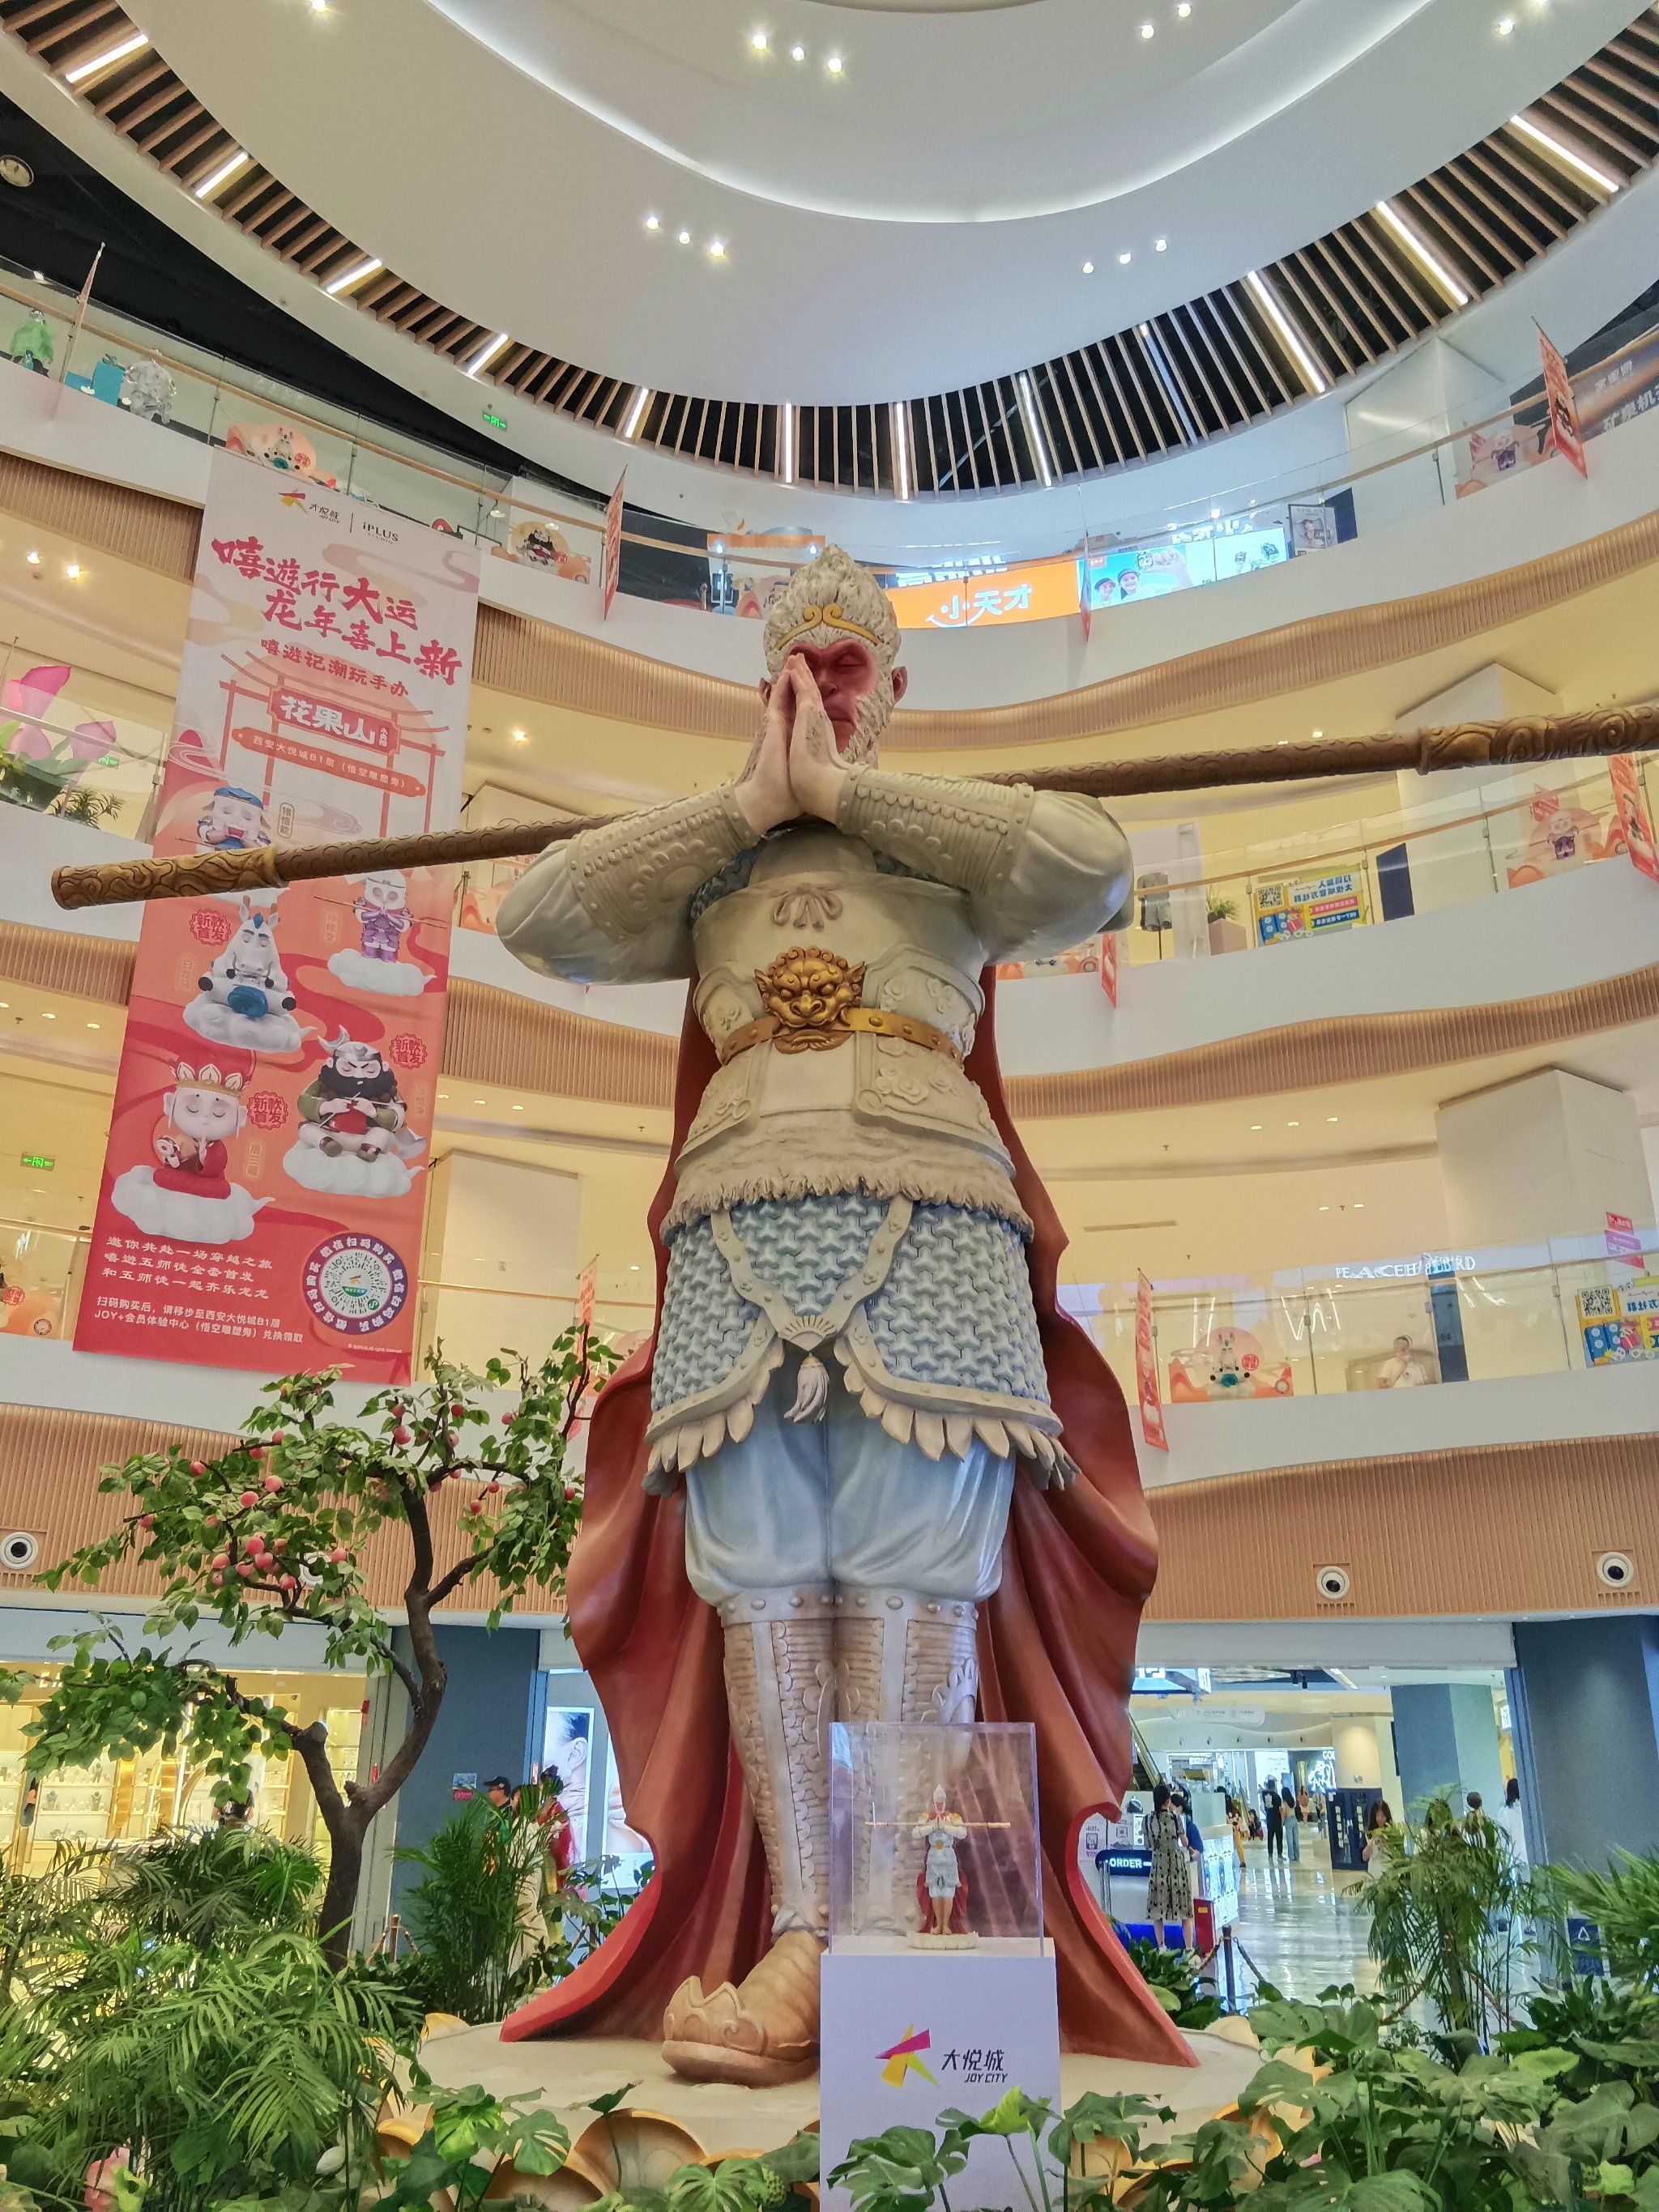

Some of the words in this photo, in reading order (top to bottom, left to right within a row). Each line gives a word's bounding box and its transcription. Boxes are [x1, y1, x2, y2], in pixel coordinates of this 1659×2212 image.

[309, 503, 339, 520] 大悦城
[363, 522, 399, 542] iPLUS
[932, 584, 1033, 624] 小天才
[263, 589, 463, 686] 龙年喜上新
[280, 694, 375, 745] 花果山
[1109, 1857, 1143, 1869] ORDER
[941, 2048, 1004, 2071] 大悦城
[964, 2073, 983, 2083] JOY
[985, 2073, 1008, 2083] CITY
